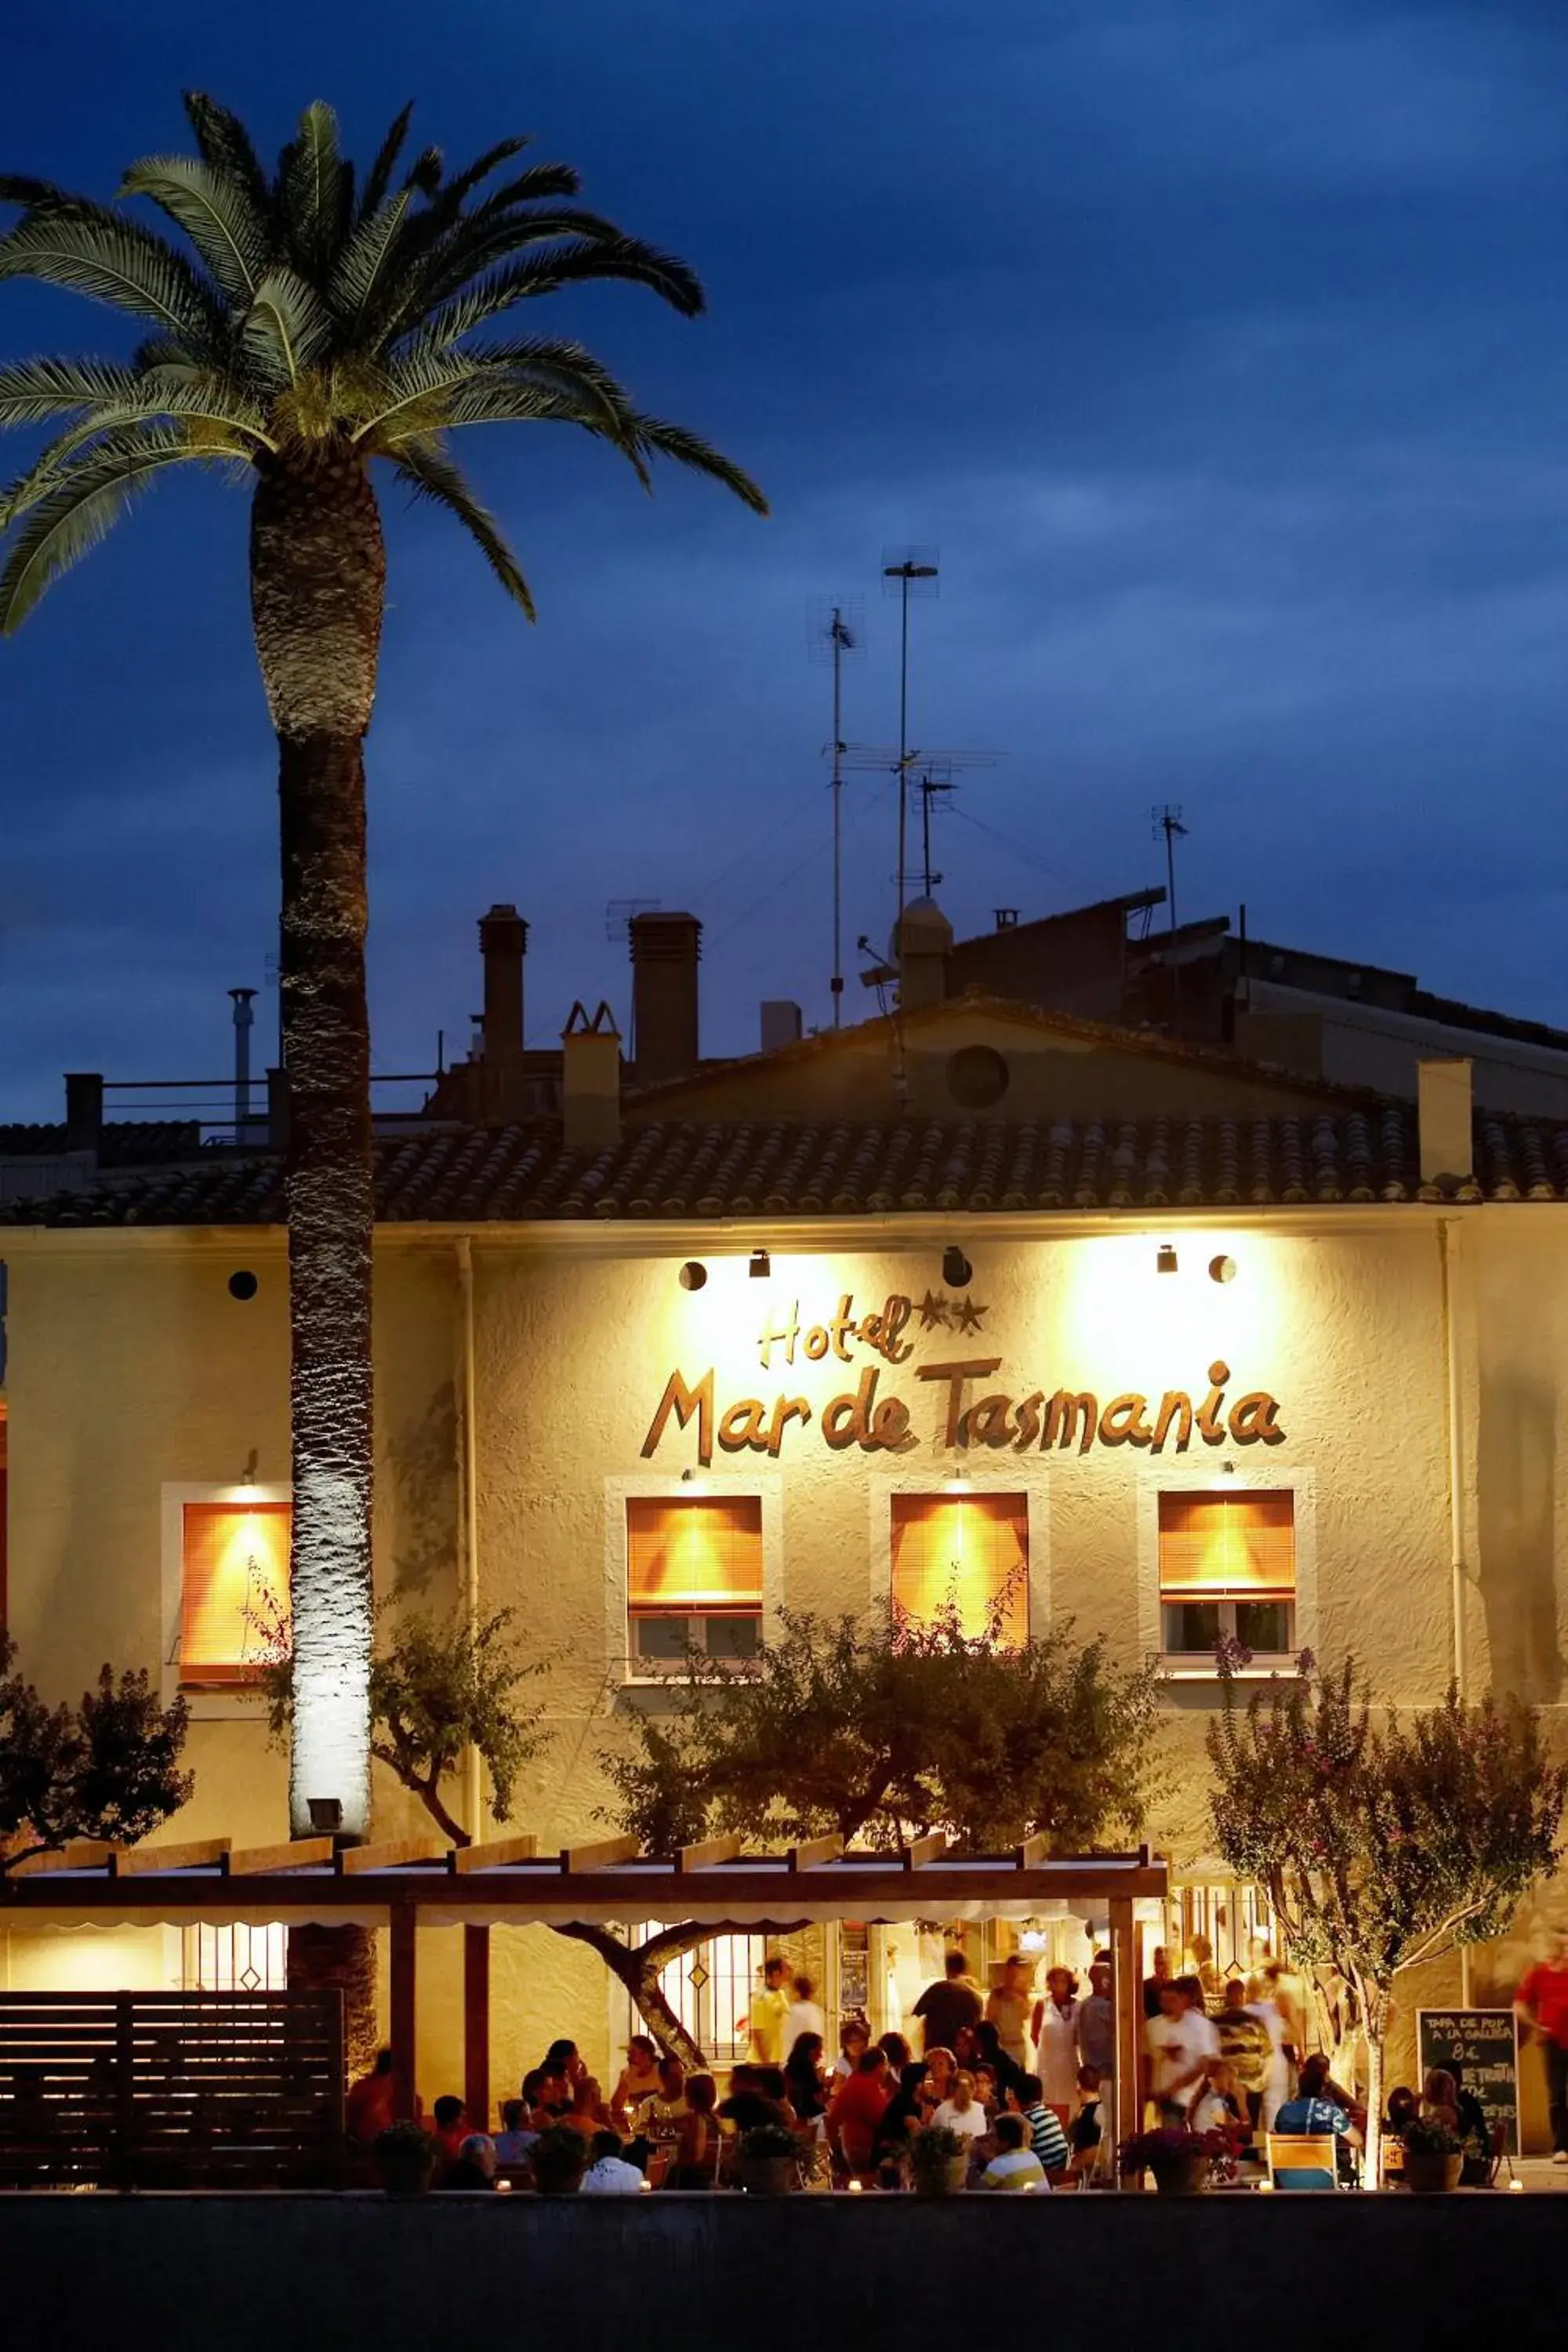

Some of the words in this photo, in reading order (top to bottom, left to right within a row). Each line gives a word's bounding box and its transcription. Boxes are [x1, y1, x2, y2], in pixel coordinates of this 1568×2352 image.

[757, 1292, 914, 1370] Hotel
[640, 1367, 812, 1468] Mar
[822, 1364, 920, 1454] de
[915, 1357, 1287, 1457] Tasmania
[1426, 2017, 1456, 2028] TAPA
[1460, 2017, 1478, 2028] DE
[1432, 2030, 1443, 2040] A
[1447, 2028, 1462, 2039] LA
